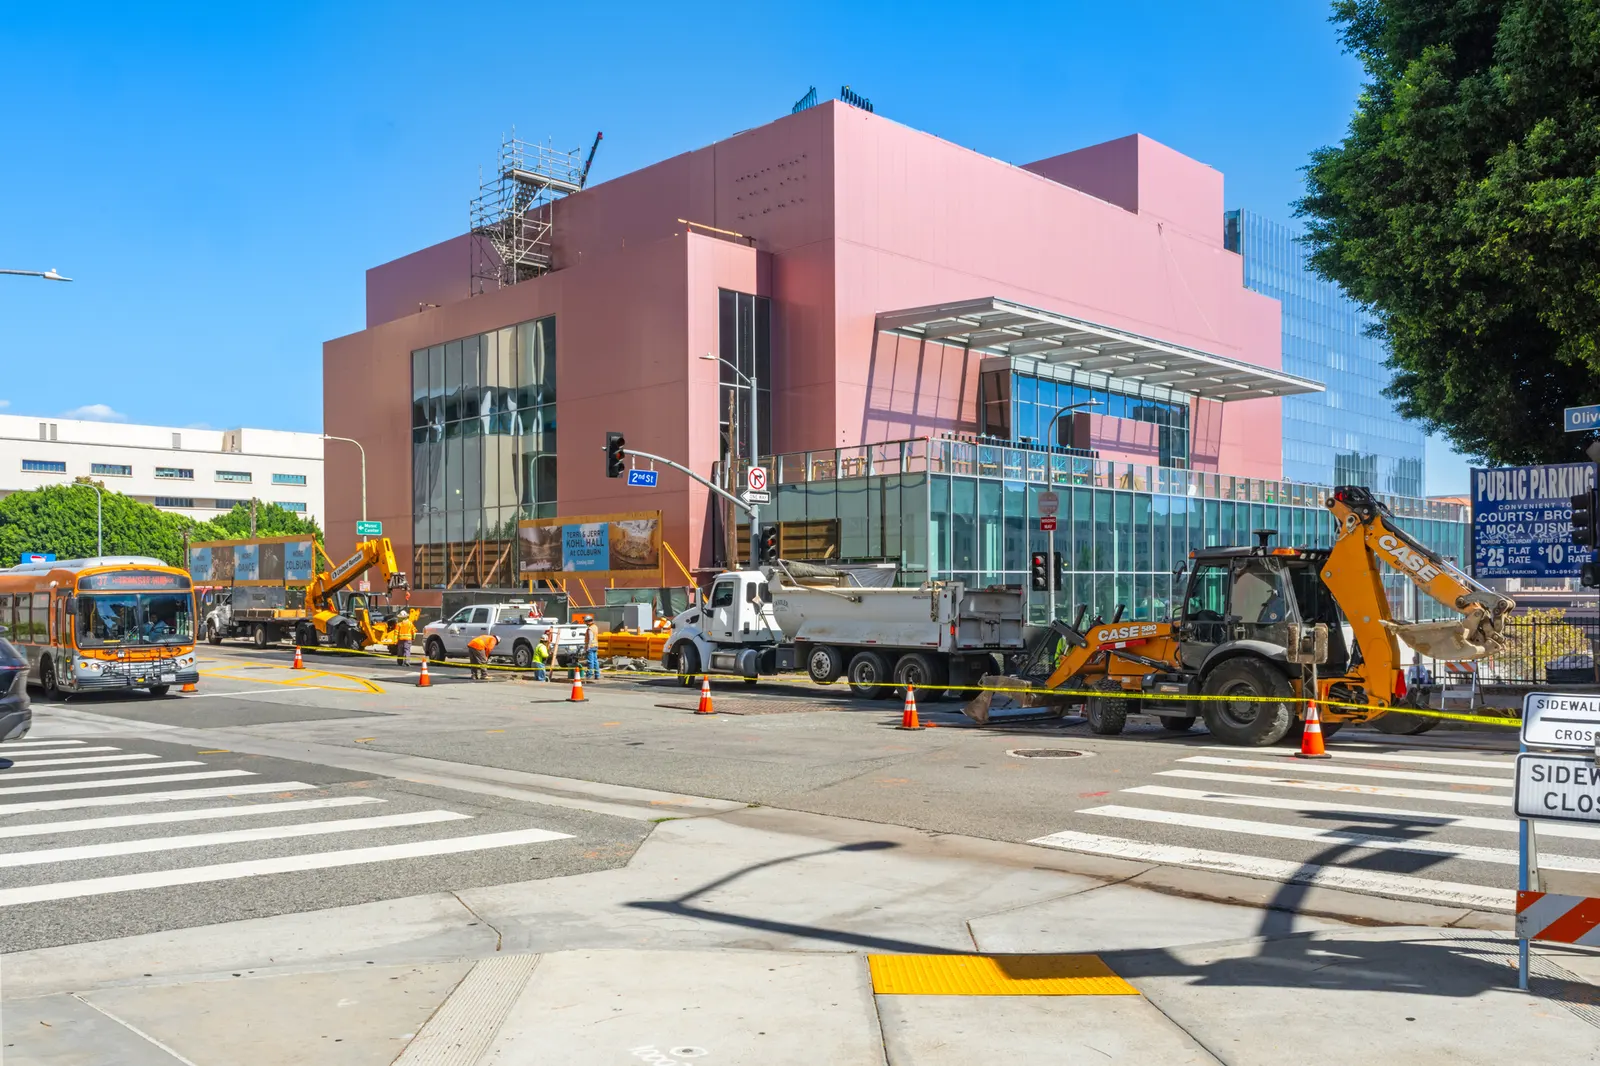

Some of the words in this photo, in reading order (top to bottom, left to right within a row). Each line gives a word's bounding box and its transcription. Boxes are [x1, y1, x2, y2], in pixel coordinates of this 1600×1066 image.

[1572, 412, 1600, 424] Oliv
[632, 472, 645, 483] 2nd
[646, 474, 654, 483] St
[1478, 469, 1526, 502] PUBLIC
[1530, 466, 1594, 499] PARKING
[586, 538, 604, 547] HALL
[1508, 547, 1531, 555] FLAT
[1378, 534, 1440, 582] CASE
[194, 564, 208, 573] MUSIC
[239, 563, 255, 572] DANCE
[286, 560, 311, 570] COLBURN
[337, 562, 349, 575] United
[97, 576, 108, 586] 37
[1098, 626, 1139, 641] CASE
